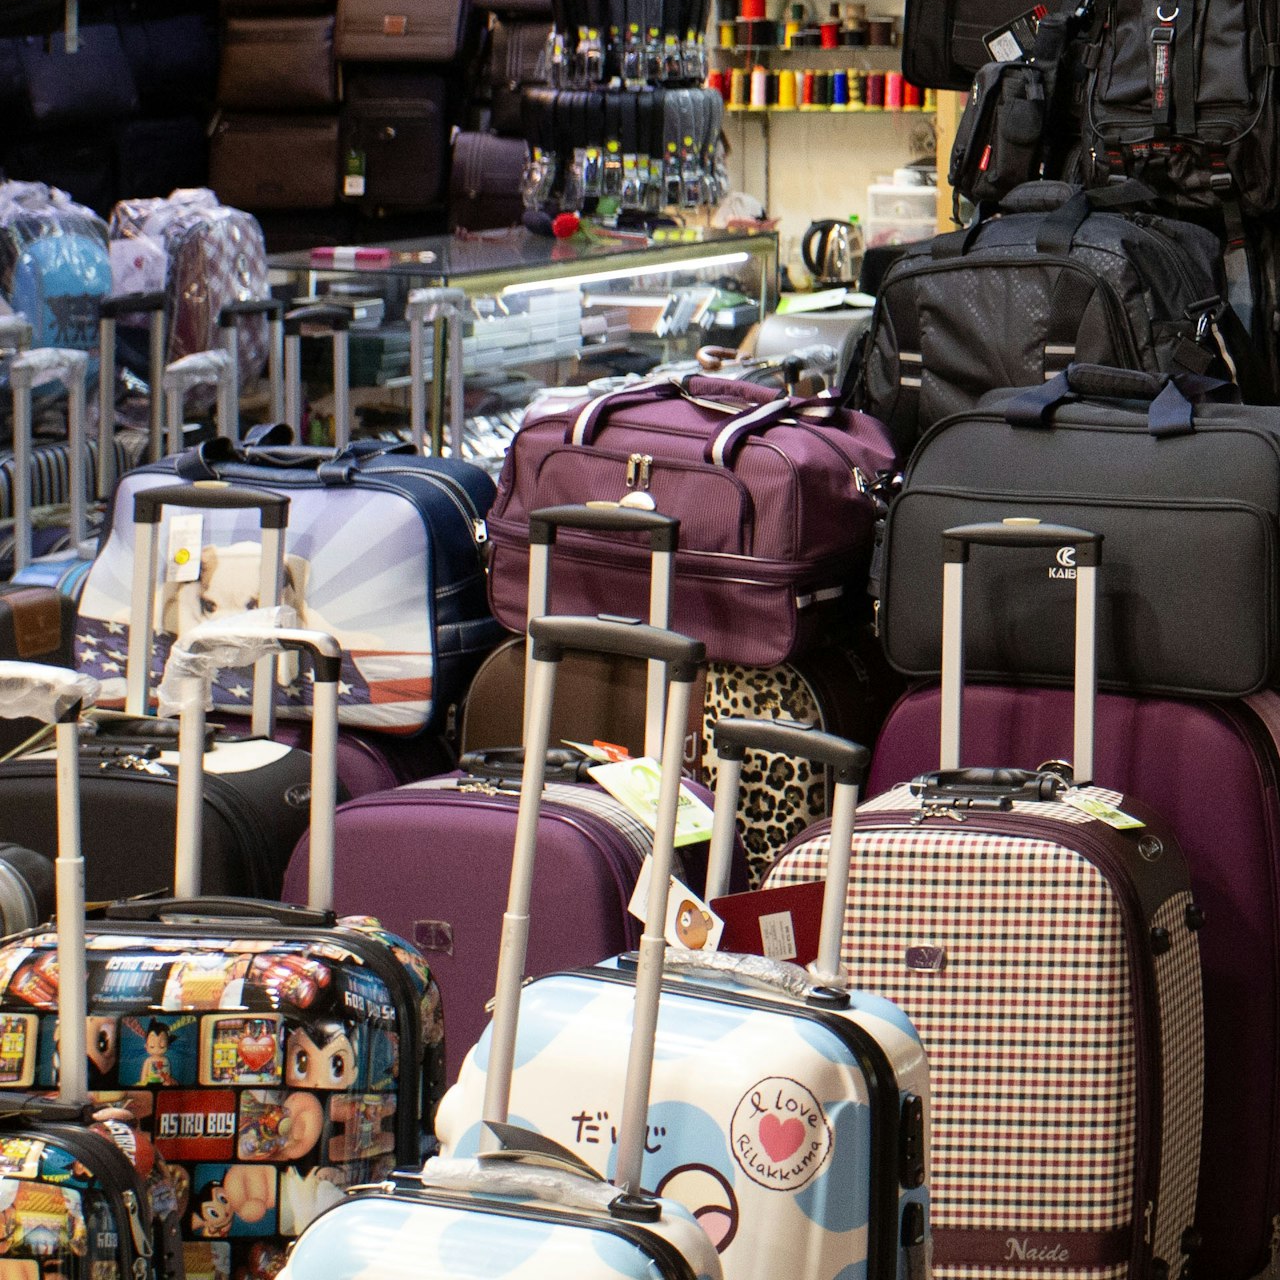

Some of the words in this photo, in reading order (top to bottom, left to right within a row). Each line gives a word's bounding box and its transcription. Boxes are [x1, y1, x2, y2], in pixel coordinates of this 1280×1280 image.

[776, 1090, 819, 1127] love
[160, 1113, 205, 1138] ASTRO
[206, 1112, 236, 1137] BOY
[736, 1134, 823, 1181] Rilakkuma
[1004, 1237, 1070, 1261] Naide
